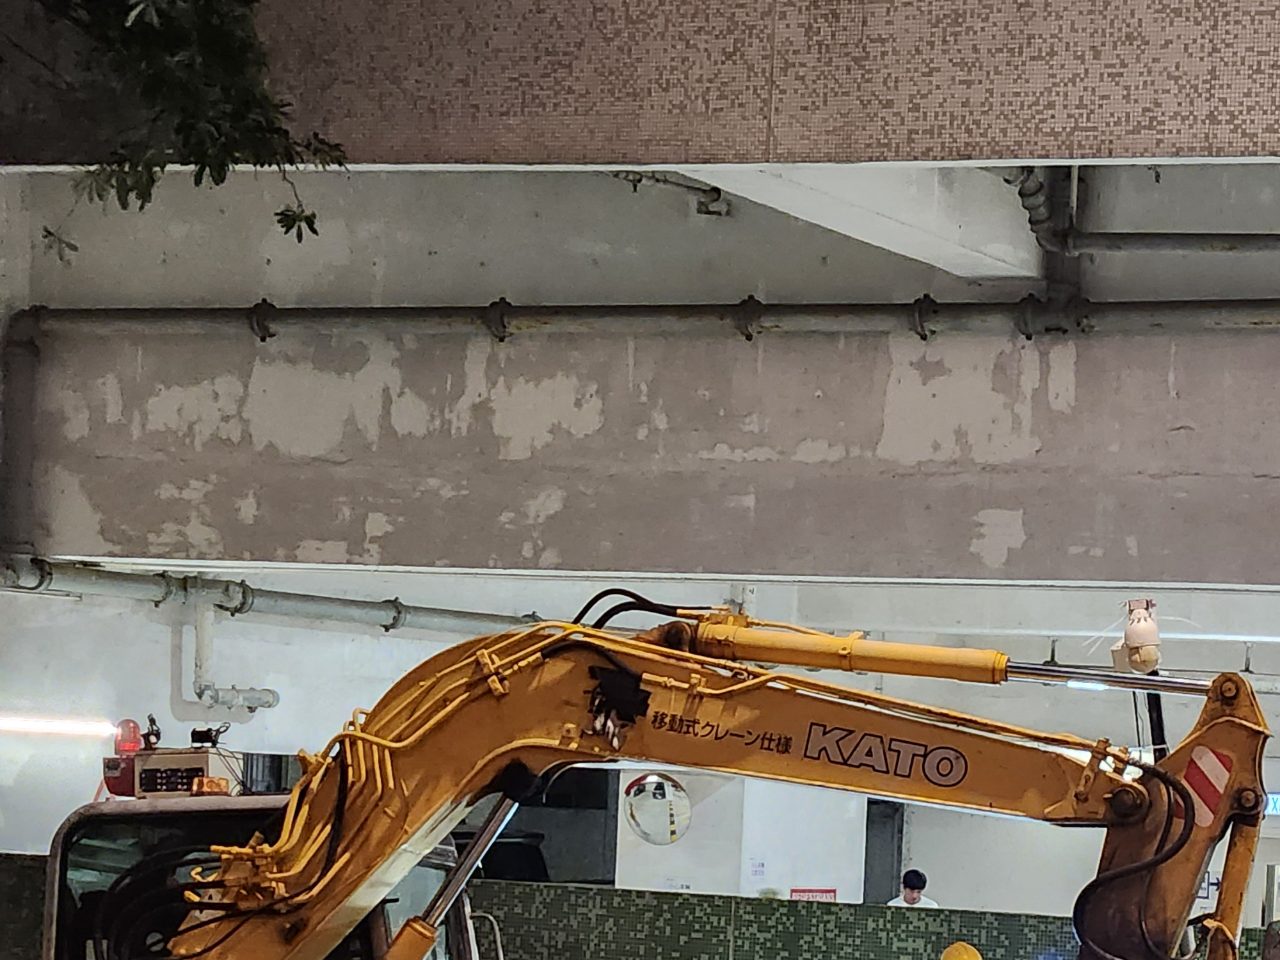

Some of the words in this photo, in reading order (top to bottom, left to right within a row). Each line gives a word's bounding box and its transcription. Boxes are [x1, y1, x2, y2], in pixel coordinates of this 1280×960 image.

[651, 710, 793, 755] 移動式クレーン仕様
[803, 722, 968, 788] KATO
